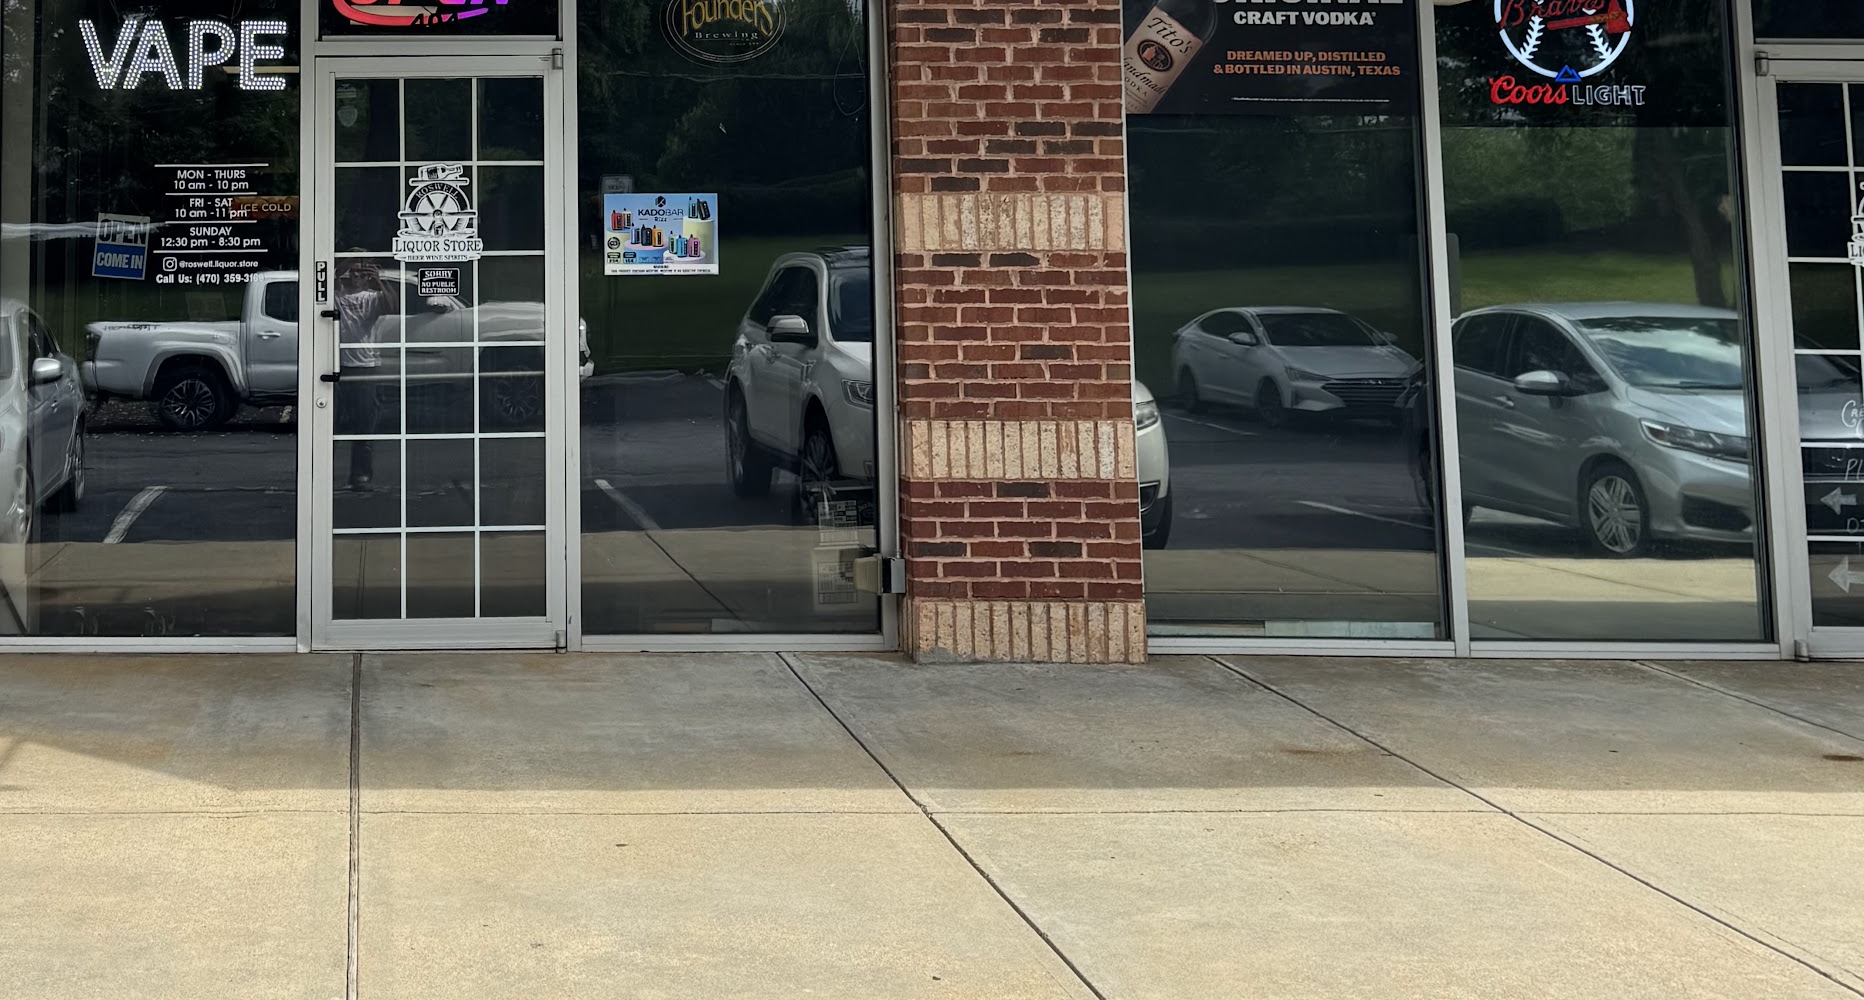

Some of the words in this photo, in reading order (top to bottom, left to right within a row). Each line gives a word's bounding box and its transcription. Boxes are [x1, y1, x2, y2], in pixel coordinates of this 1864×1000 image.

[1233, 11, 1299, 25] CRAFT
[695, 31, 759, 40] Brewing
[1147, 17, 1193, 54] Tito's
[78, 19, 288, 91] VAPE
[1227, 51, 1293, 62] DREAMED
[1295, 51, 1316, 63] UP,
[1318, 52, 1386, 63] DISTILLED
[1224, 65, 1285, 75] BOTTLED
[1287, 65, 1300, 75] IN
[1302, 66, 1356, 77] AUSTIN,
[1358, 66, 1400, 76] TEXAS
[1489, 74, 1570, 105] Coors
[1572, 84, 1646, 106] LIGHT
[177, 170, 204, 179] MON
[214, 170, 246, 179] THURS
[174, 180, 185, 190] 10
[188, 182, 206, 190] am
[217, 180, 228, 190] 10
[231, 182, 249, 191] pm
[415, 183, 459, 199] ROSWELL
[189, 198, 204, 207] FRI
[214, 198, 233, 207] SAT
[240, 204, 258, 212] ICE
[261, 203, 291, 212] COLD
[175, 209, 185, 218] 10
[189, 210, 207, 218] am
[229, 210, 248, 220] pm
[98, 218, 147, 245] OPEN
[189, 227, 233, 236] SUNDAY
[160, 237, 187, 247] 12:30
[190, 239, 208, 249] pm
[219, 237, 240, 247] 8:30
[243, 238, 261, 248] pm
[395, 239, 440, 253] LIQUOR
[443, 239, 482, 252] STORE
[96, 252, 129, 268] COME
[130, 255, 144, 270] IN
[179, 259, 259, 269] @roswell.liquor.store
[156, 274, 174, 284] Call
[178, 274, 193, 284] Us:
[196, 274, 220, 285] (470)
[425, 270, 453, 279] SORRY
[316, 262, 326, 302] PULL
